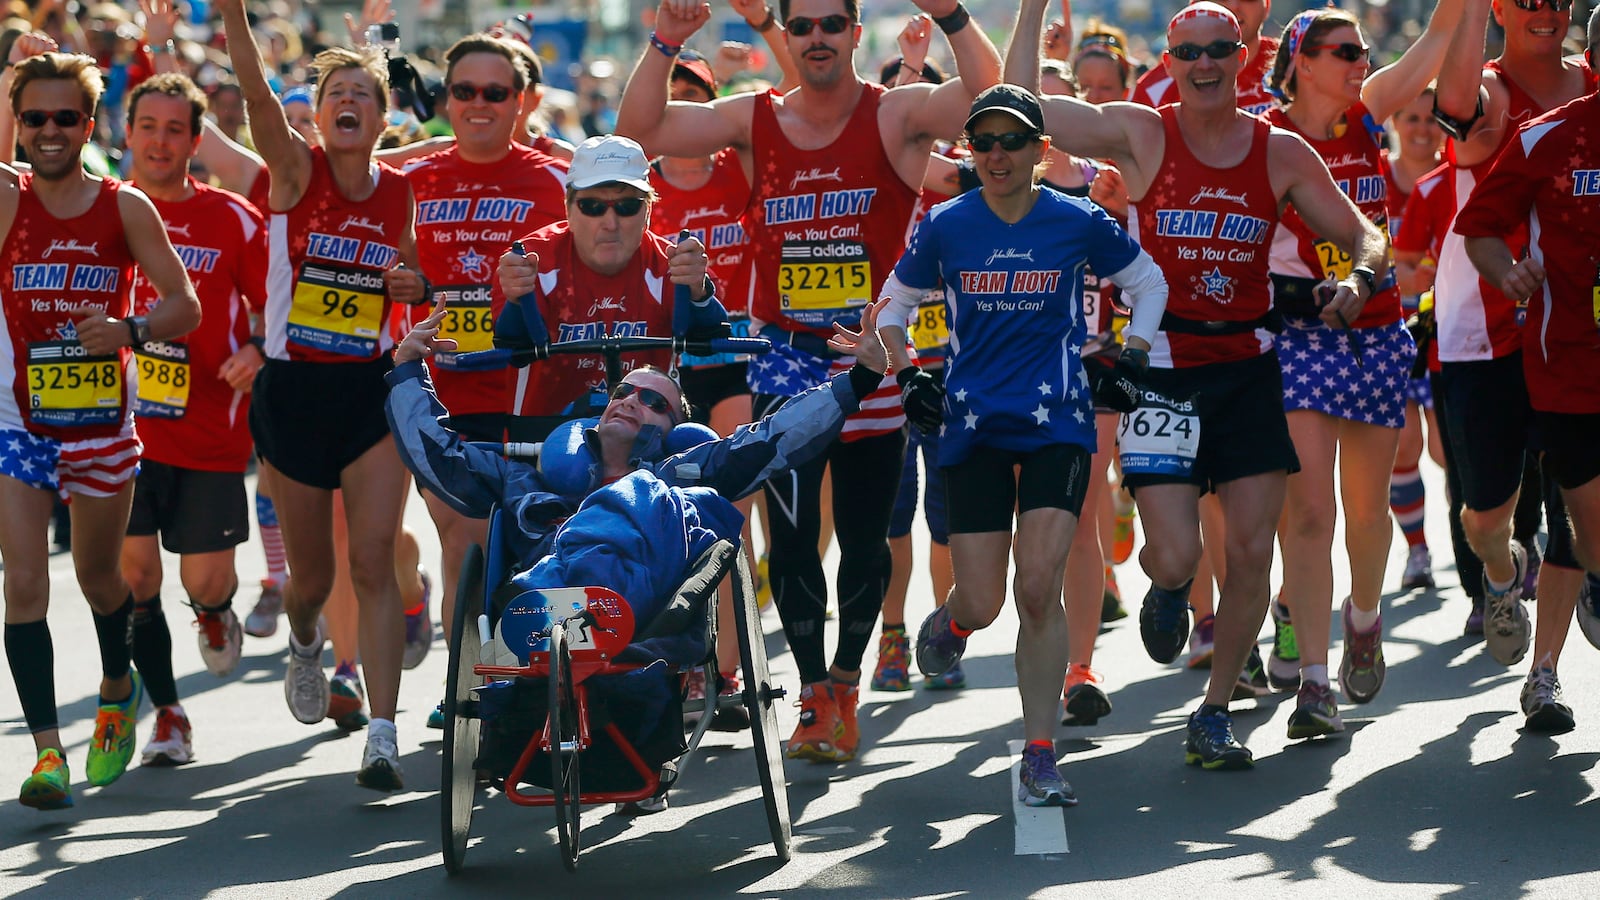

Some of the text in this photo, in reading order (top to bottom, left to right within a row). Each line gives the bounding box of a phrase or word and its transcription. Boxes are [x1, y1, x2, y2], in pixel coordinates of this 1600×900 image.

[1572, 169, 1600, 196] TE
[764, 188, 877, 226] TEAM HOYT
[1189, 186, 1249, 208] John Hancock
[416, 196, 535, 226] TEAM HOYT
[432, 228, 513, 243] Yes You Can!
[804, 228, 828, 241] You
[829, 223, 860, 240] Can!
[1156, 208, 1219, 239] TEAM
[306, 231, 361, 263] TEAM
[812, 243, 864, 258] adidas
[984, 248, 1035, 266] John Hancock
[1177, 246, 1255, 262] Yes You Can!
[12, 262, 69, 292] TEAM
[70, 265, 120, 293] HOYT
[336, 272, 384, 289] adidas
[781, 264, 866, 291] 32215
[959, 271, 1009, 294] TEAM
[1010, 269, 1062, 294] HOYT
[31, 298, 51, 313] Yes
[54, 298, 78, 312] You
[322, 290, 359, 319] 96
[781, 293, 791, 308] 6
[975, 299, 1045, 312] Yes You Can!
[439, 310, 494, 333] 386
[31, 363, 117, 391] 32548
[136, 359, 187, 388] 988
[31, 393, 41, 409] 6
[1120, 410, 1193, 440] 9624
